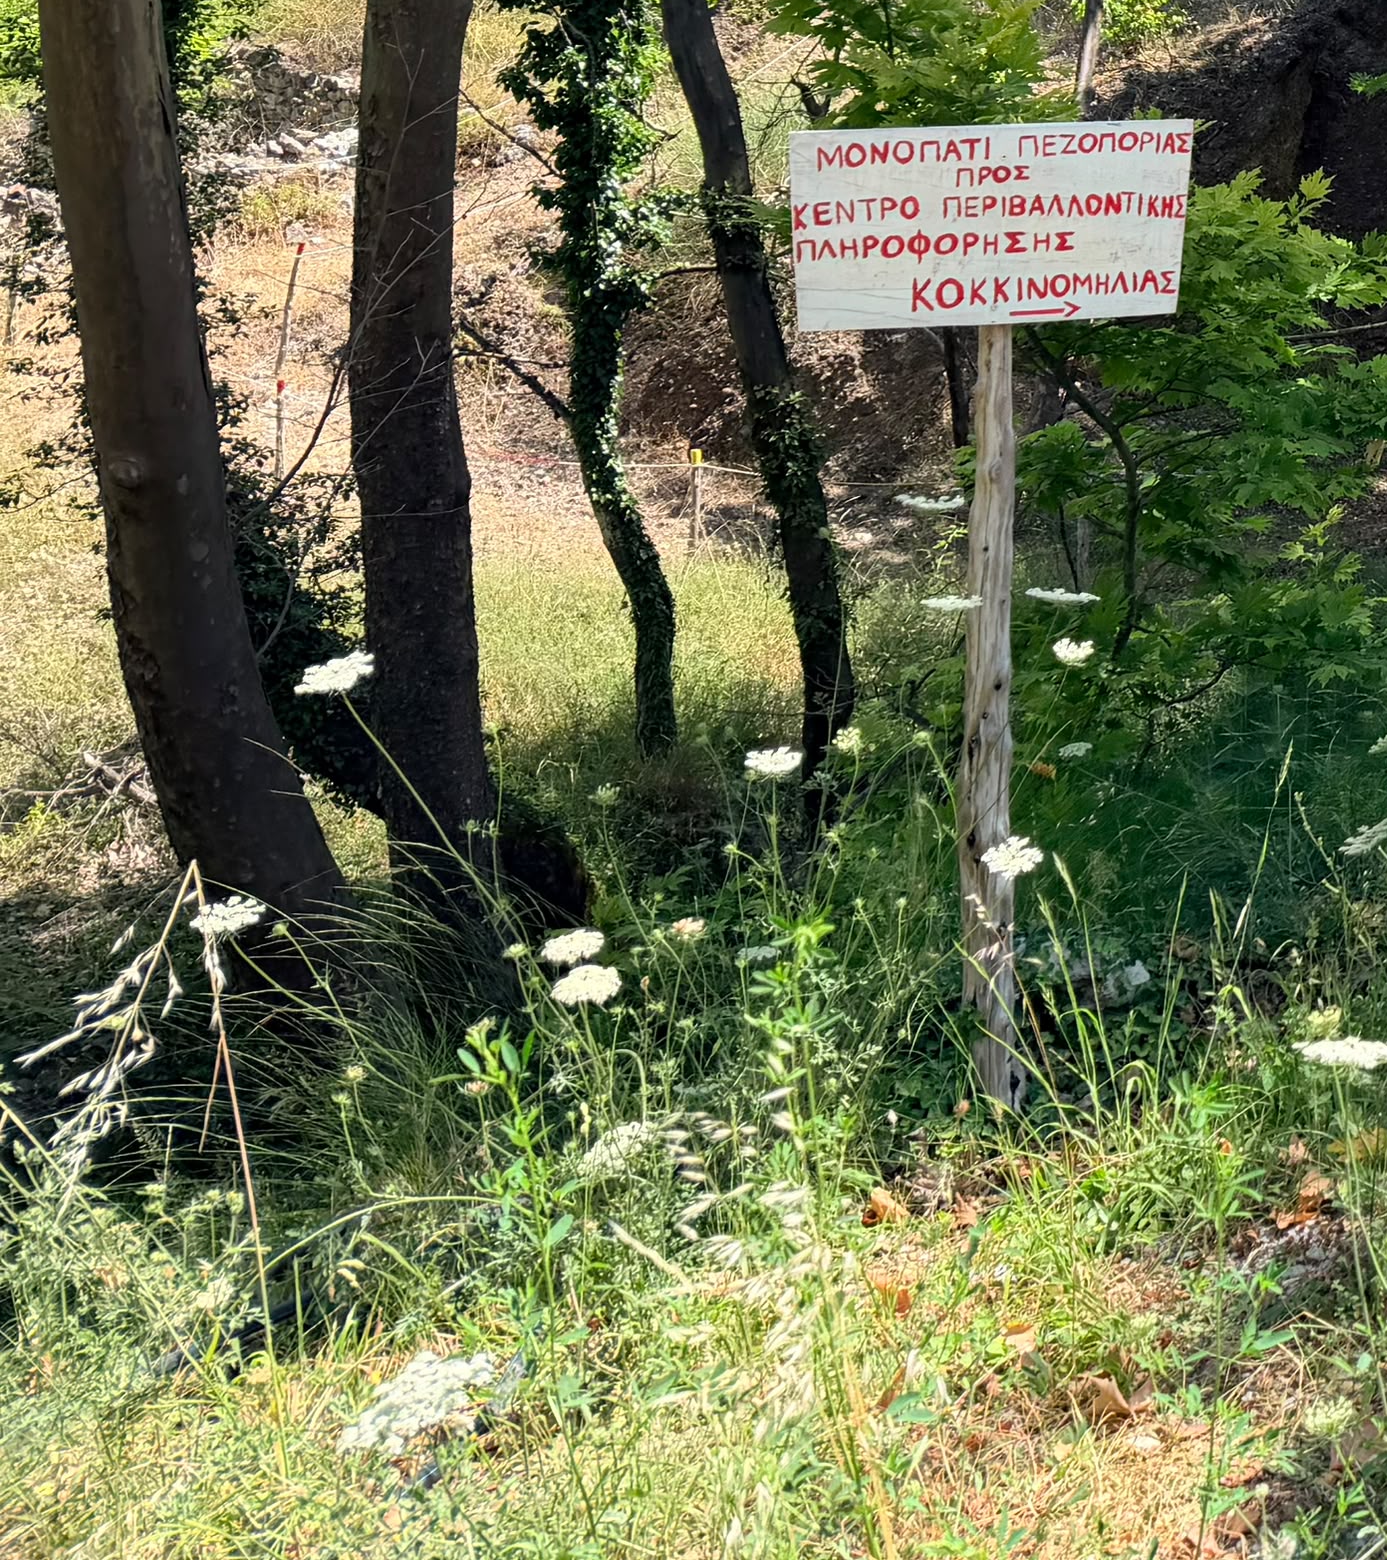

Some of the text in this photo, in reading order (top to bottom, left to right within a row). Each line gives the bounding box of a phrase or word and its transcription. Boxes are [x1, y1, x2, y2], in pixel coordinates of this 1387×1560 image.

[816, 131, 1192, 172] ΜΟΝΟΠΑΤΙ ΠΕΖΟΠΟΡΙΑΣ
[956, 165, 1030, 187] ΠΡΟΣ
[793, 191, 1187, 231] ΚΕΝΤΡΟ ΠΕΡΙΒΑΛΛΟΝΤΙΚΗΣ
[796, 229, 1075, 264] ΠΛΗΡΟΦΟΡΗΣΗΣ
[911, 269, 1177, 312] ΚΟΚΚΙΝΟΜΗΛΙΑΣ
